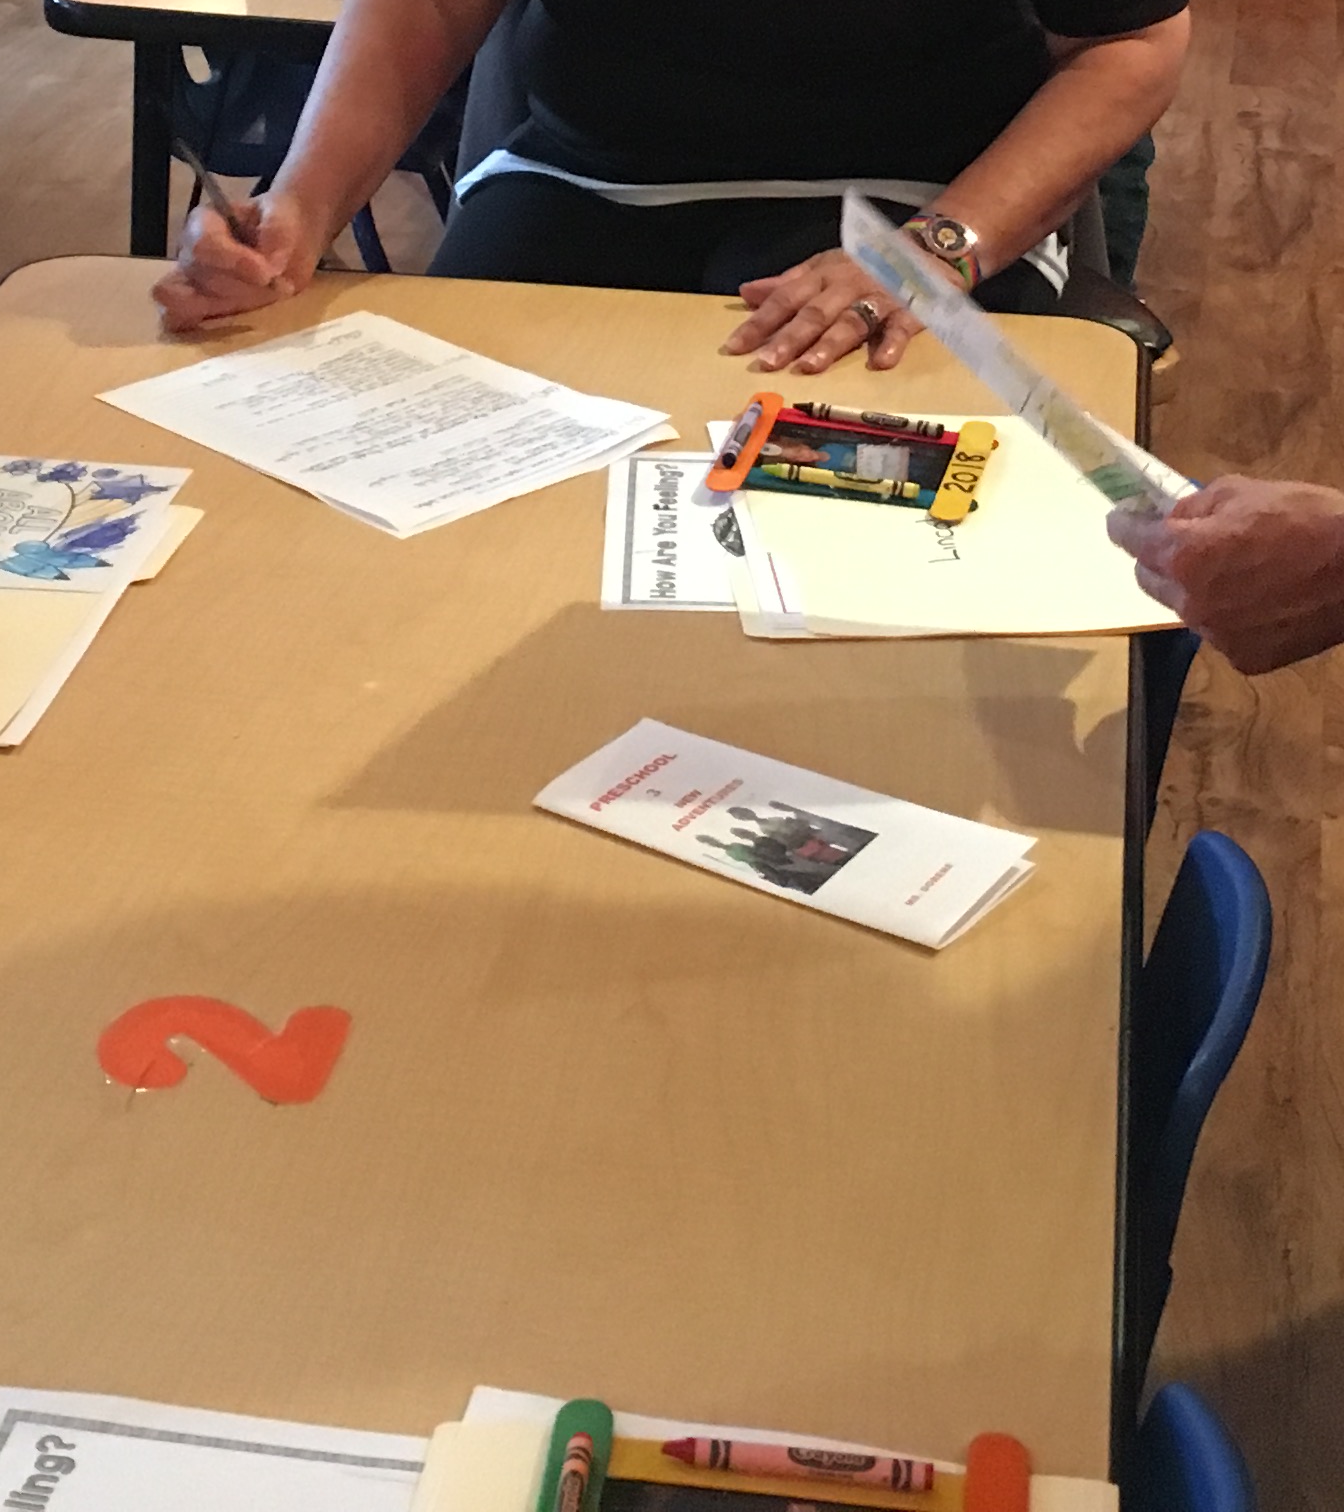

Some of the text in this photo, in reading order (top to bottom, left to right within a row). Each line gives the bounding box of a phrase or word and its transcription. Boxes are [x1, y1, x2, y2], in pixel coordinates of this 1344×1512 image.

[943, 451, 985, 494] 2018
[8, 504, 63, 535] ALL
[651, 541, 677, 567] Are
[650, 569, 676, 598] How
[589, 750, 678, 812] PRESCHOOL
[647, 787, 662, 799] 3
[671, 777, 746, 833] ADVENTURES
[674, 787, 704, 809] NEW
[96, 995, 352, 1107] 2
